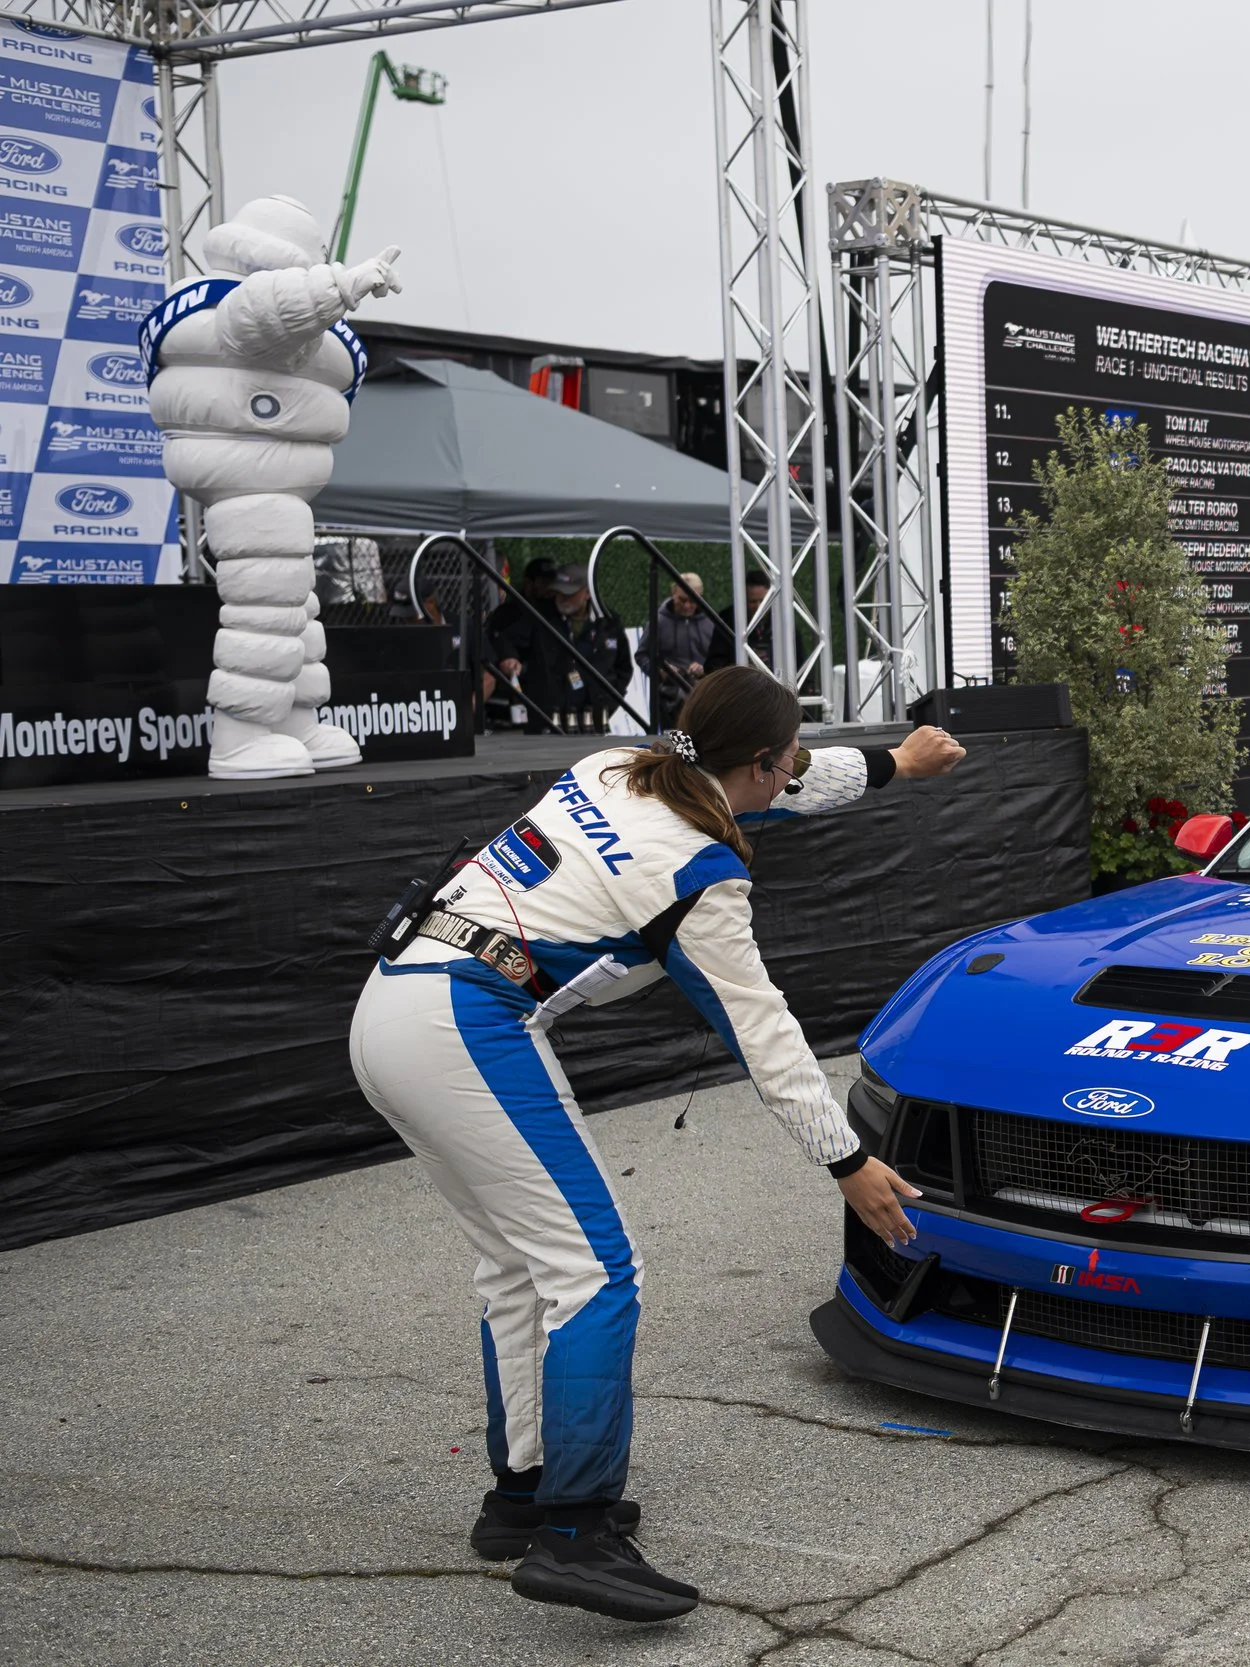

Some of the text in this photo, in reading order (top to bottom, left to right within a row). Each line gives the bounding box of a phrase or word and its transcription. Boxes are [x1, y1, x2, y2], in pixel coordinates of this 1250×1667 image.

[2, 37, 93, 65] RACING
[10, 77, 100, 103] MUSTANG
[11, 93, 102, 117] CHALLENGE
[45, 112, 71, 124] NORTH
[0, 140, 45, 169] Ford
[0, 178, 68, 197] ACING
[131, 227, 165, 253] For
[114, 261, 165, 276] RACI
[114, 295, 160, 311] MUST
[1025, 326, 1076, 343] MUSTANG
[1096, 325, 1196, 360] WEATHERTECH
[1025, 341, 1076, 354] CHALLENGE
[1096, 355, 1127, 376] RACE
[1129, 359, 1135, 377] 1
[1143, 363, 1203, 387] UNOFFICIAL
[1205, 371, 1248, 392] RESULTS
[85, 391, 149, 406] RACIN
[994, 404, 1011, 420] 11.
[1165, 415, 1209, 433] TOM TAIT
[86, 442, 163, 456] CHALLENG
[1165, 434, 1212, 449] WHEELHOUSE
[995, 451, 1012, 467] 12.
[1166, 457, 1199, 473] PAOLO
[1189, 477, 1215, 490] RACING
[71, 487, 118, 514] Ford
[997, 497, 1013, 513] 13.
[1168, 500, 1238, 517] WALTER BOBKO
[53, 525, 139, 537] RACING
[1185, 519, 1213, 531] SMITHER
[1214, 520, 1239, 532] RACING
[56, 559, 143, 571] MUSTANG
[57, 574, 144, 585] CHALLENGE
[1213, 584, 1233, 598] TOSI
[312, 690, 457, 746] ampionship
[138, 706, 215, 761] Sport
[501, 844, 532, 874] MICHELIN
[1064, 1046, 1230, 1072] ROUND 3 RACING
[1077, 1090, 1139, 1115] Ford
[1077, 1271, 1141, 1295] IMSA
